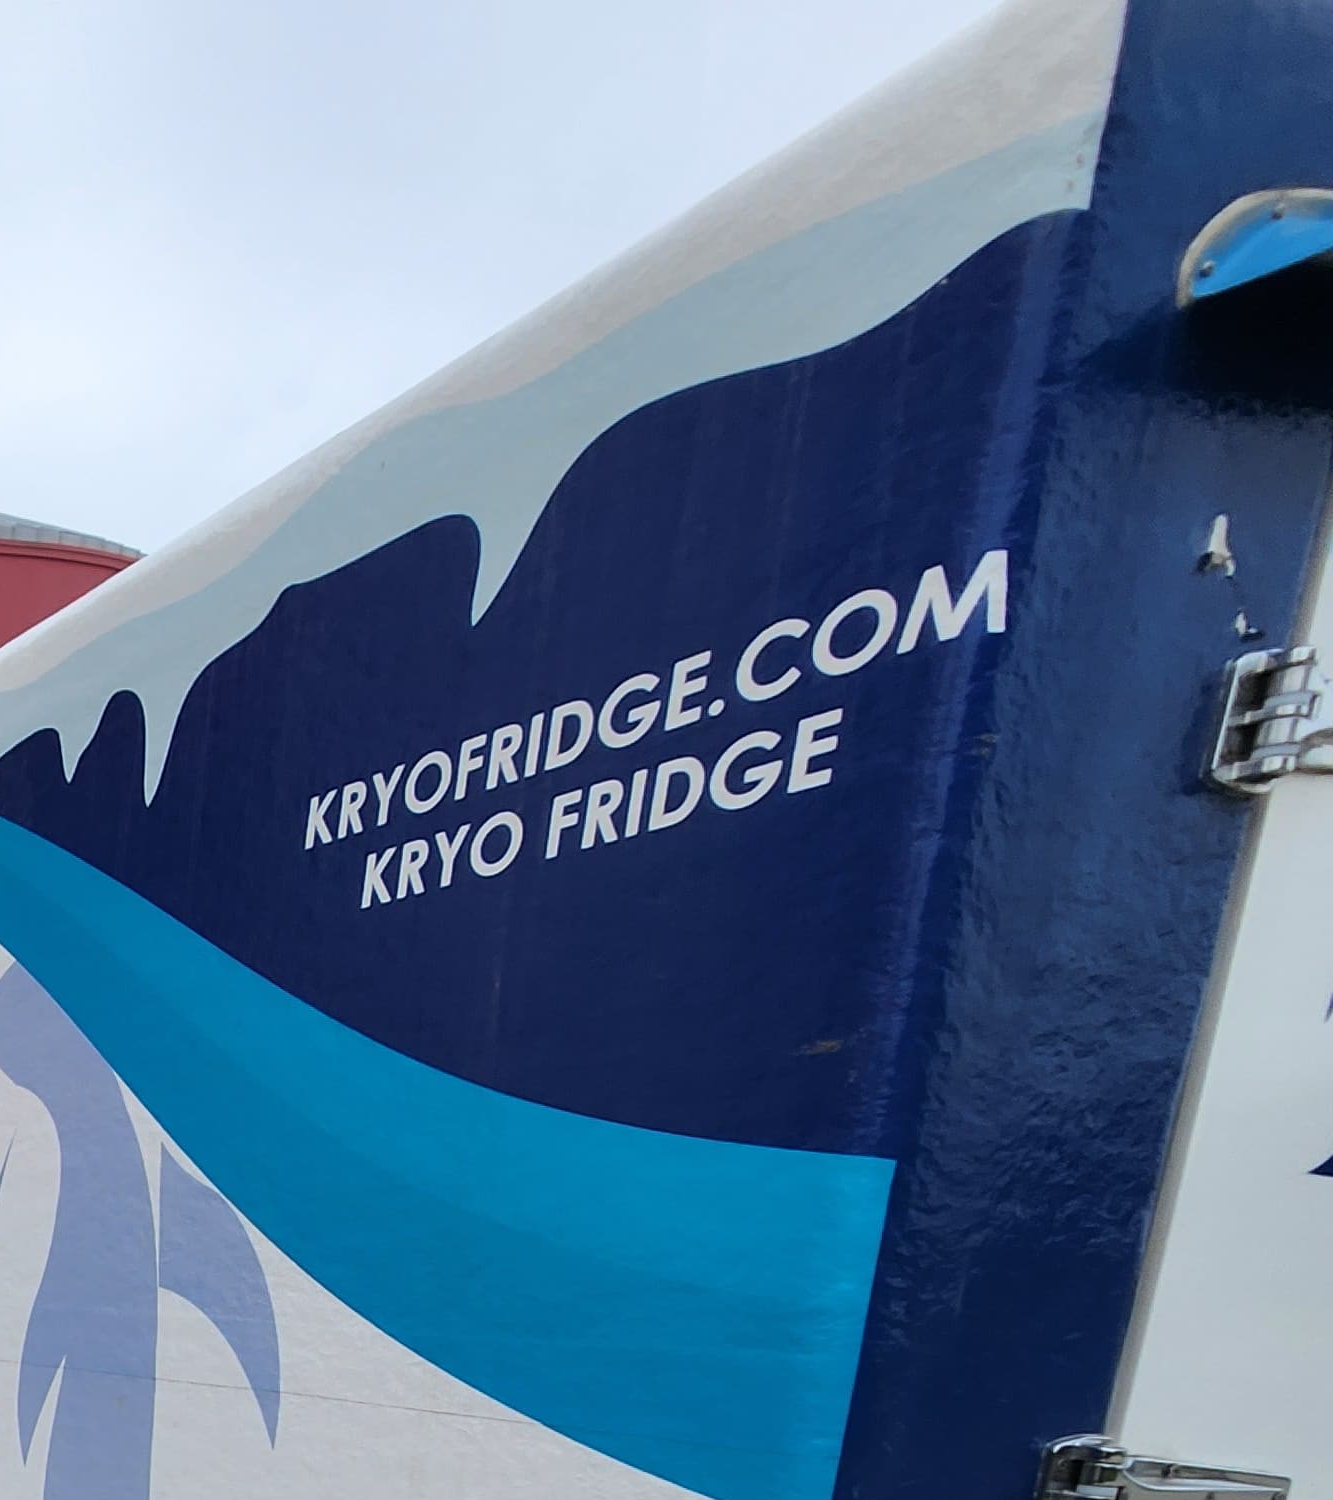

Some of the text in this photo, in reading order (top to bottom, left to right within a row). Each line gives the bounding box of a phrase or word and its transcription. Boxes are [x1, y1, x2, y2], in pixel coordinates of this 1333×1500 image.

[304, 549, 1008, 849] KRYOFRIDGE.COM
[361, 708, 844, 908] KRYO FRIDGE
